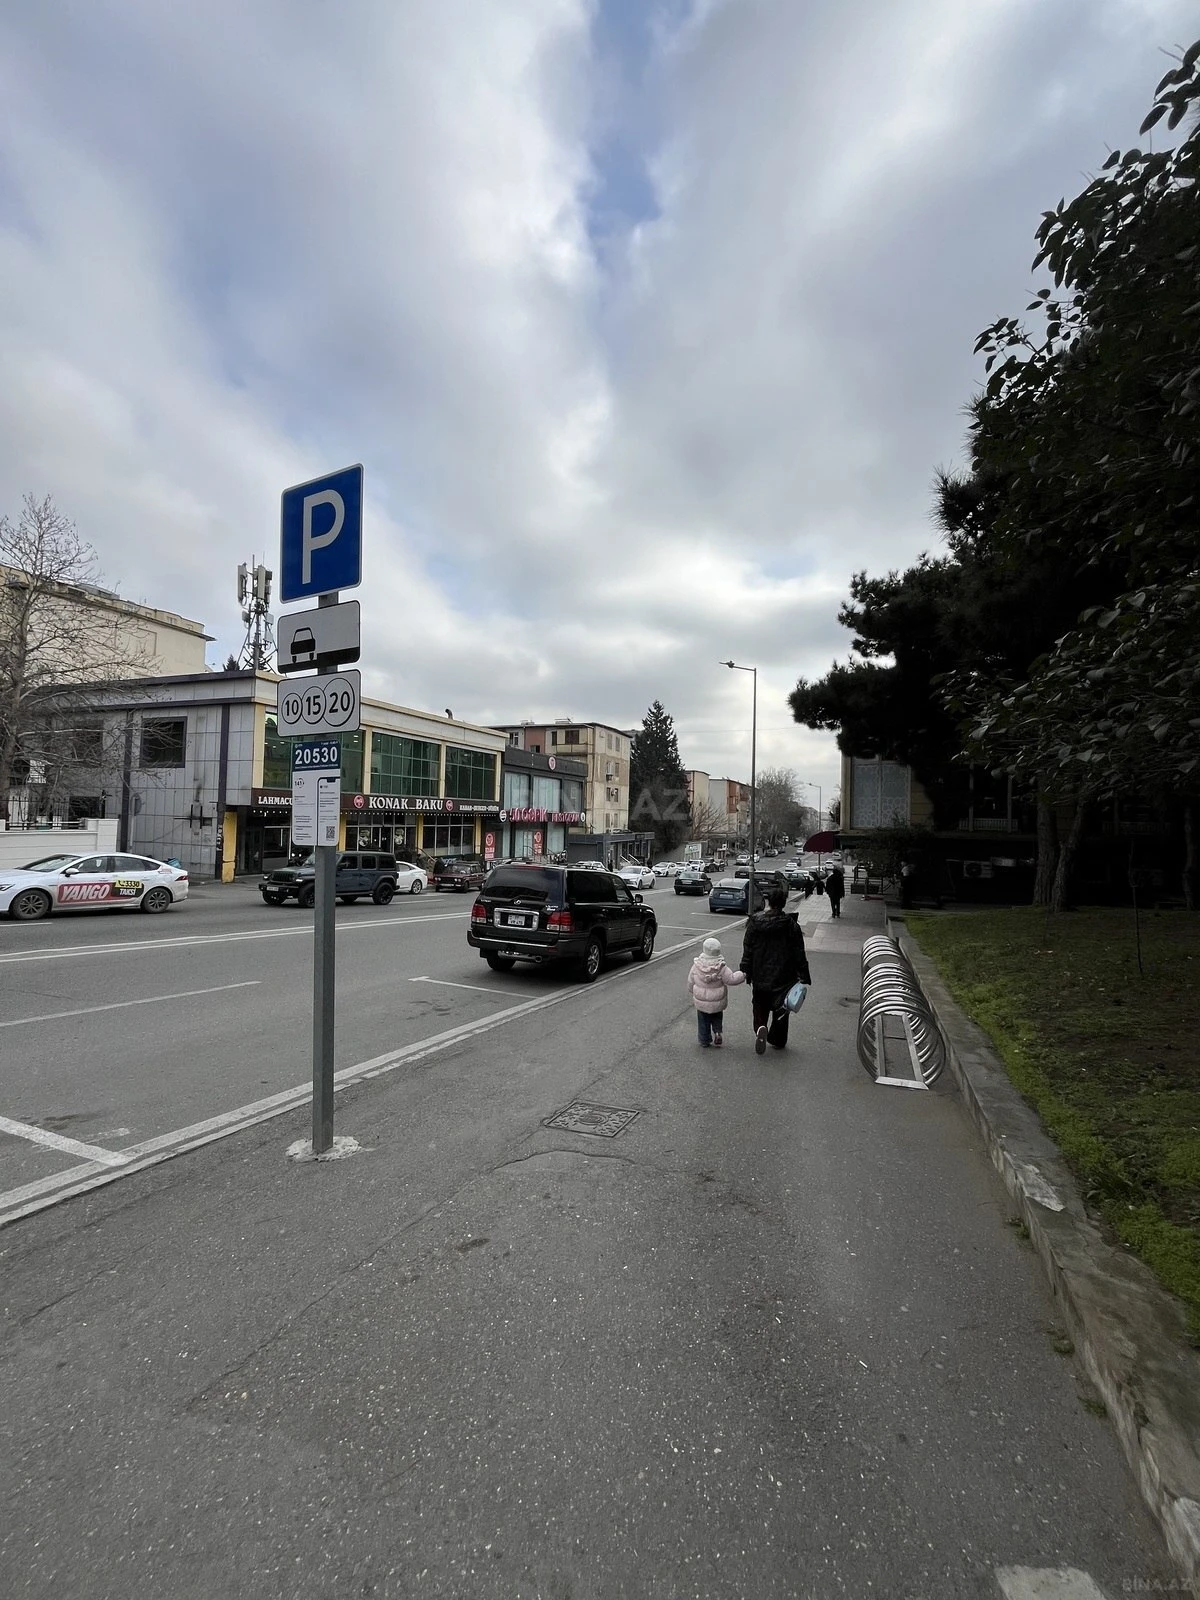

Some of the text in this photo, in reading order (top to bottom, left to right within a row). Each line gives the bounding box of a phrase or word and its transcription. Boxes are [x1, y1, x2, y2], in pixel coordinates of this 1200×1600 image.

[302, 488, 345, 585] P
[285, 691, 351, 717] 10 15 20
[295, 746, 338, 765] 20530
[61, 884, 111, 901] YANGO
